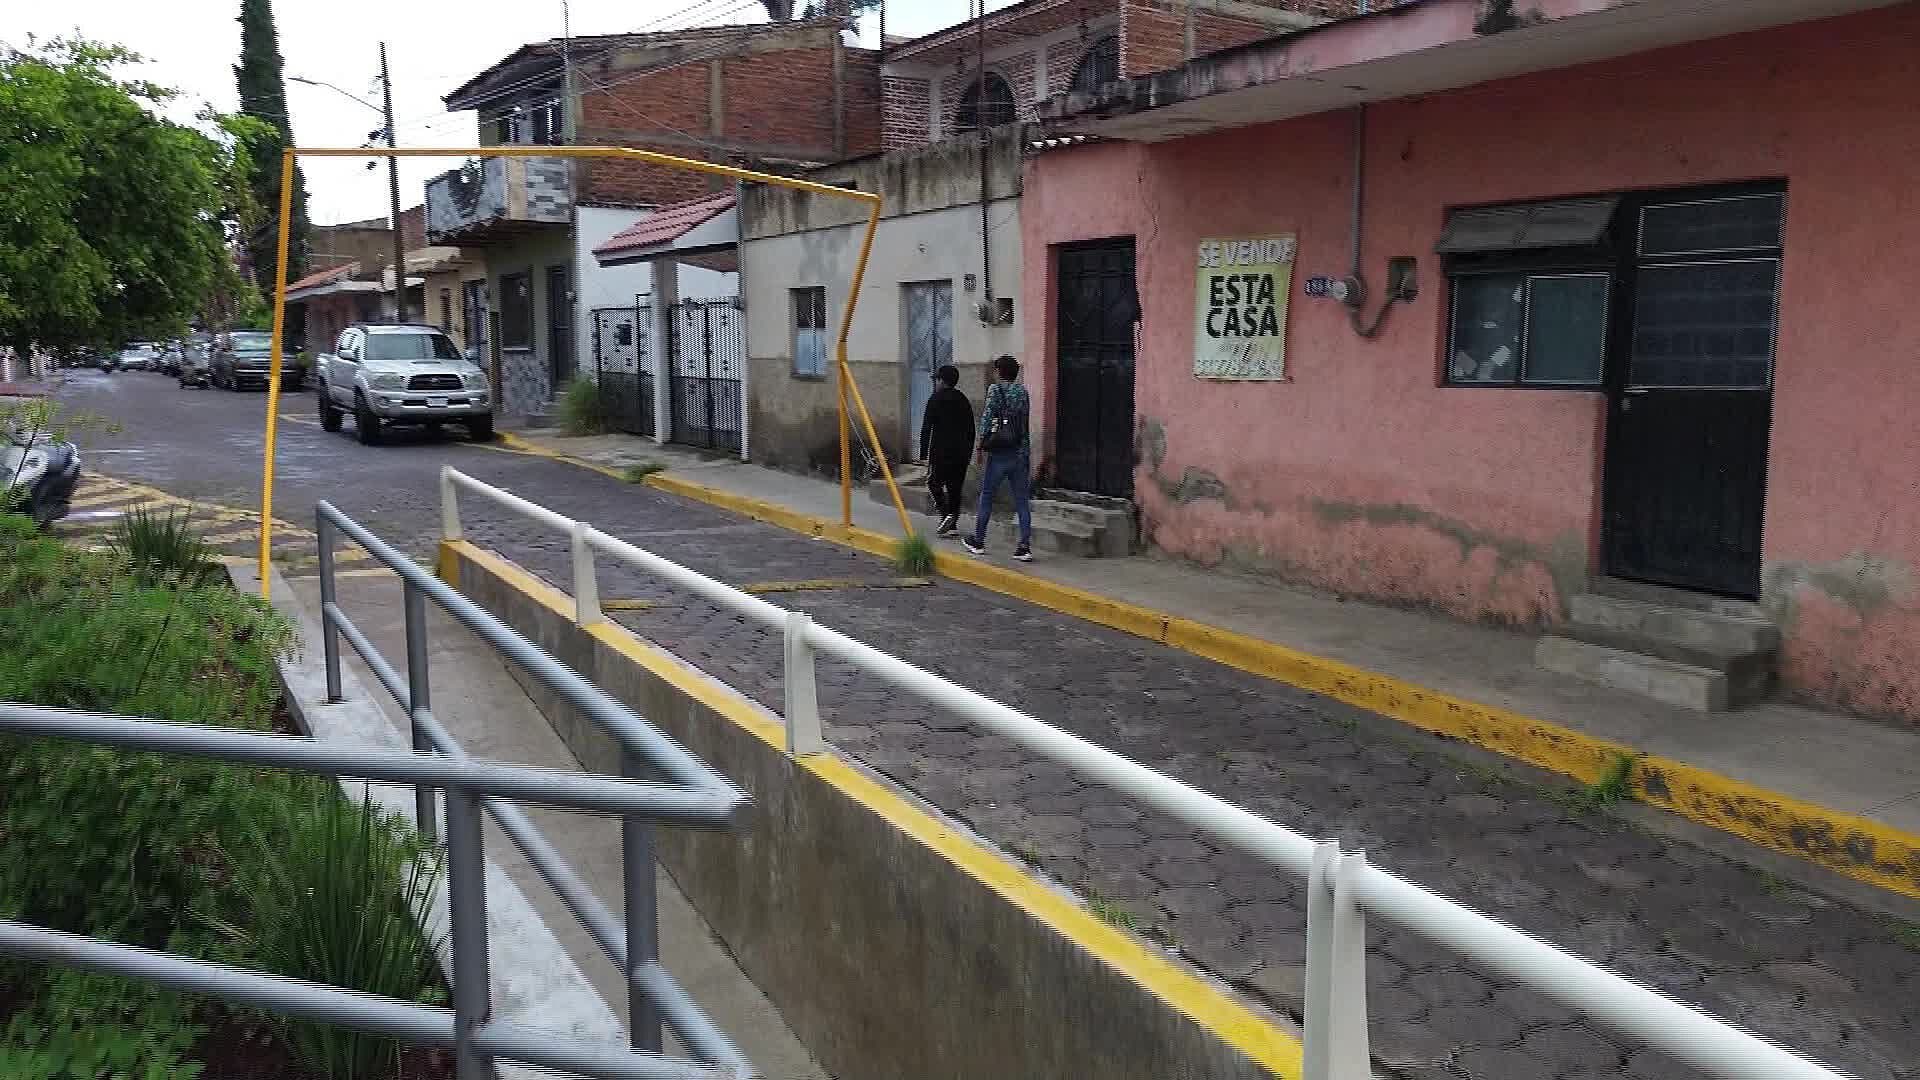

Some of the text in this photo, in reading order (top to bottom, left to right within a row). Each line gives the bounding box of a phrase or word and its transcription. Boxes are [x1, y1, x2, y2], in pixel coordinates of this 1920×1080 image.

[1199, 240, 1220, 268] SE
[1210, 273, 1275, 306] ESTA
[1206, 305, 1280, 338] CASA
